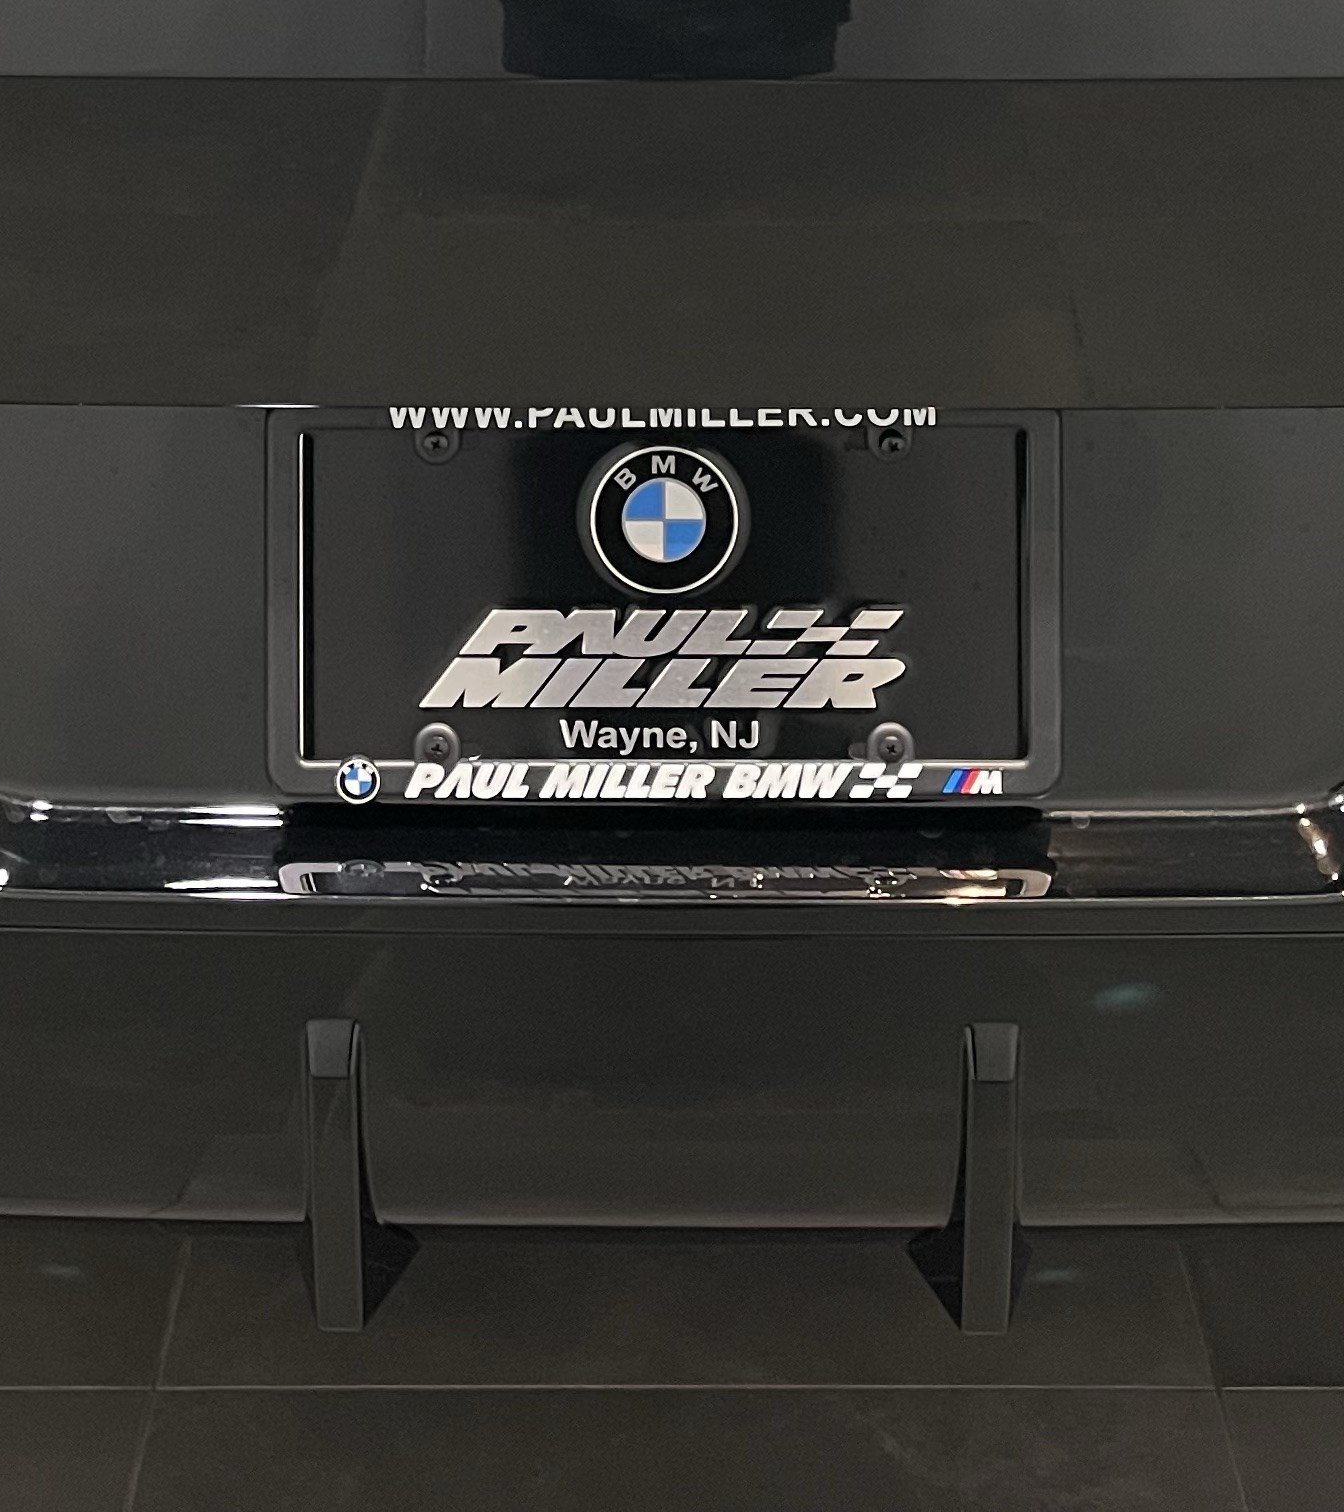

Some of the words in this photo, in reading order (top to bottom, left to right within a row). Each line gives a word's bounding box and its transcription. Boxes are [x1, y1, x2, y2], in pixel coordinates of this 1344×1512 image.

[613, 454, 719, 493] BMW
[458, 608, 753, 658] PAUL
[418, 657, 906, 709] MILLER
[559, 719, 698, 755] Wayne,
[710, 720, 760, 750] NJ
[404, 762, 530, 800] PAUL
[538, 762, 716, 800] MILLER
[722, 762, 854, 800] BMW
